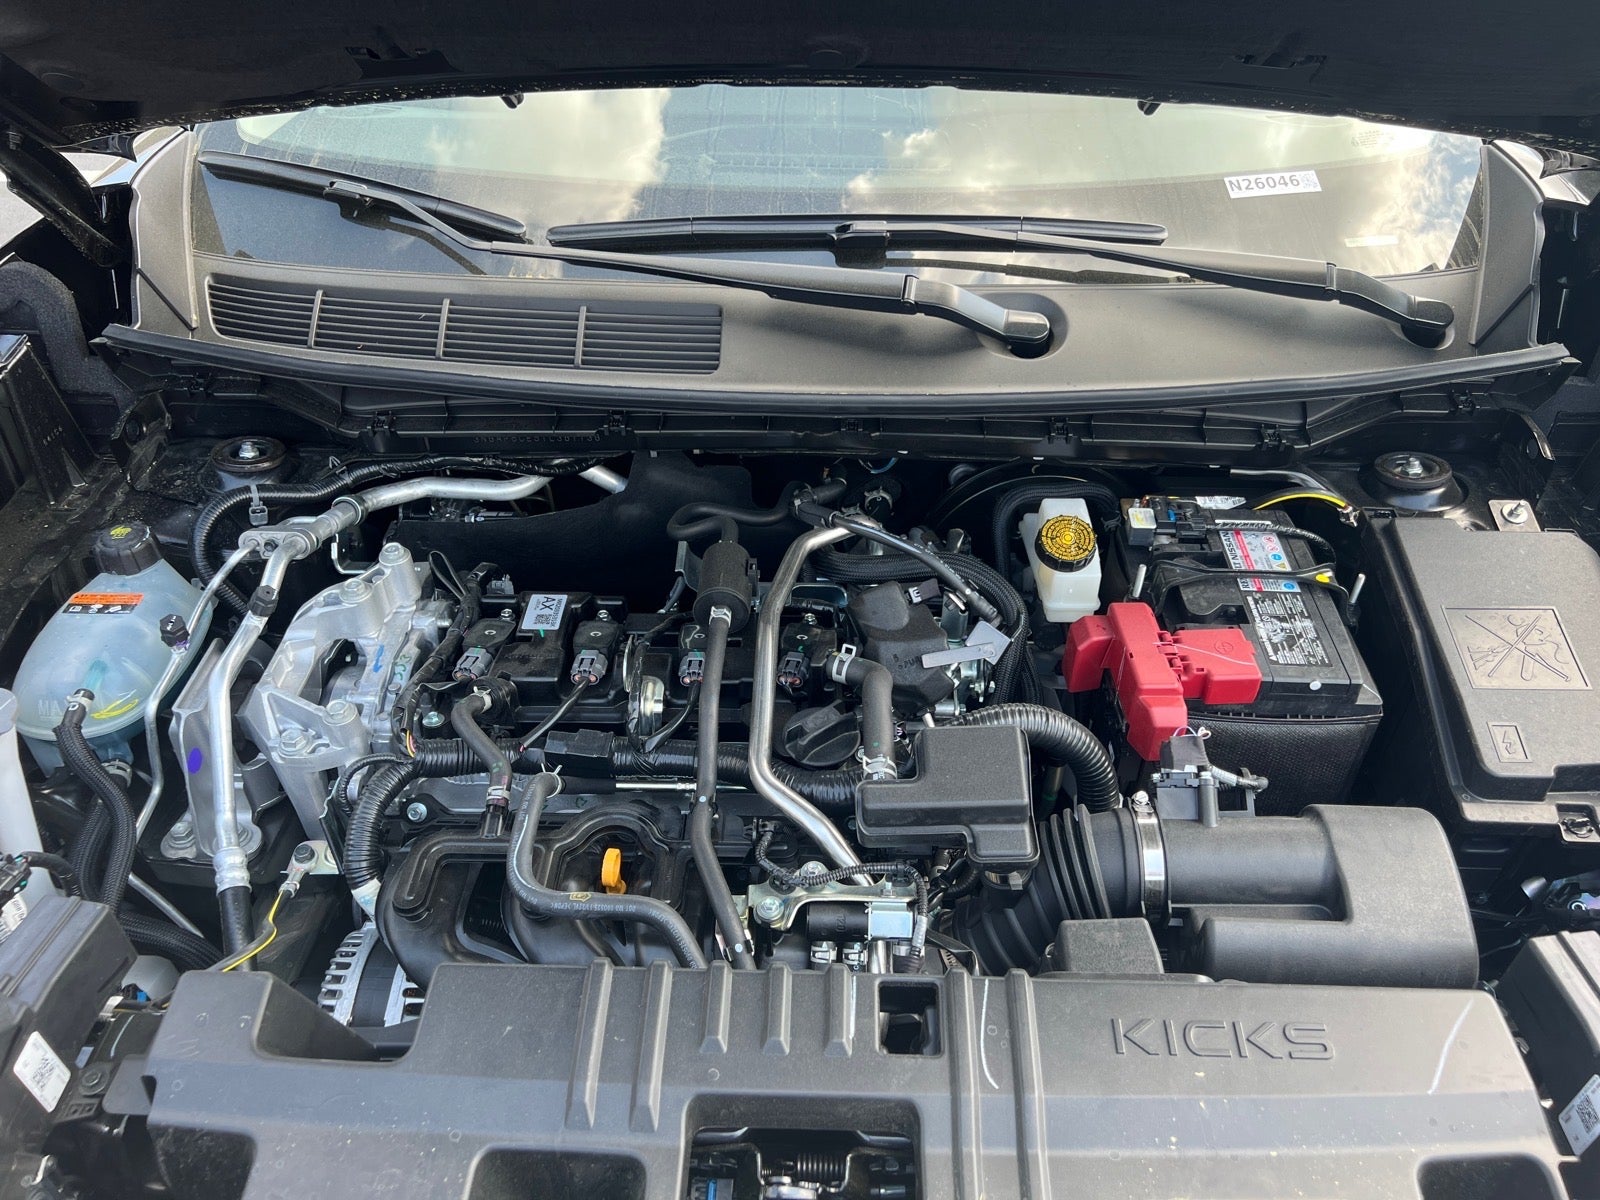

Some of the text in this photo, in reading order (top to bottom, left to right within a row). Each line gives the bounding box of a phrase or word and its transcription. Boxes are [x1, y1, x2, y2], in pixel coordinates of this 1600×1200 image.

[1227, 174, 1301, 192] N26046
[1221, 531, 1239, 561] NISSAN
[540, 596, 556, 611] AX
[1111, 1017, 1336, 1060] KICKS
